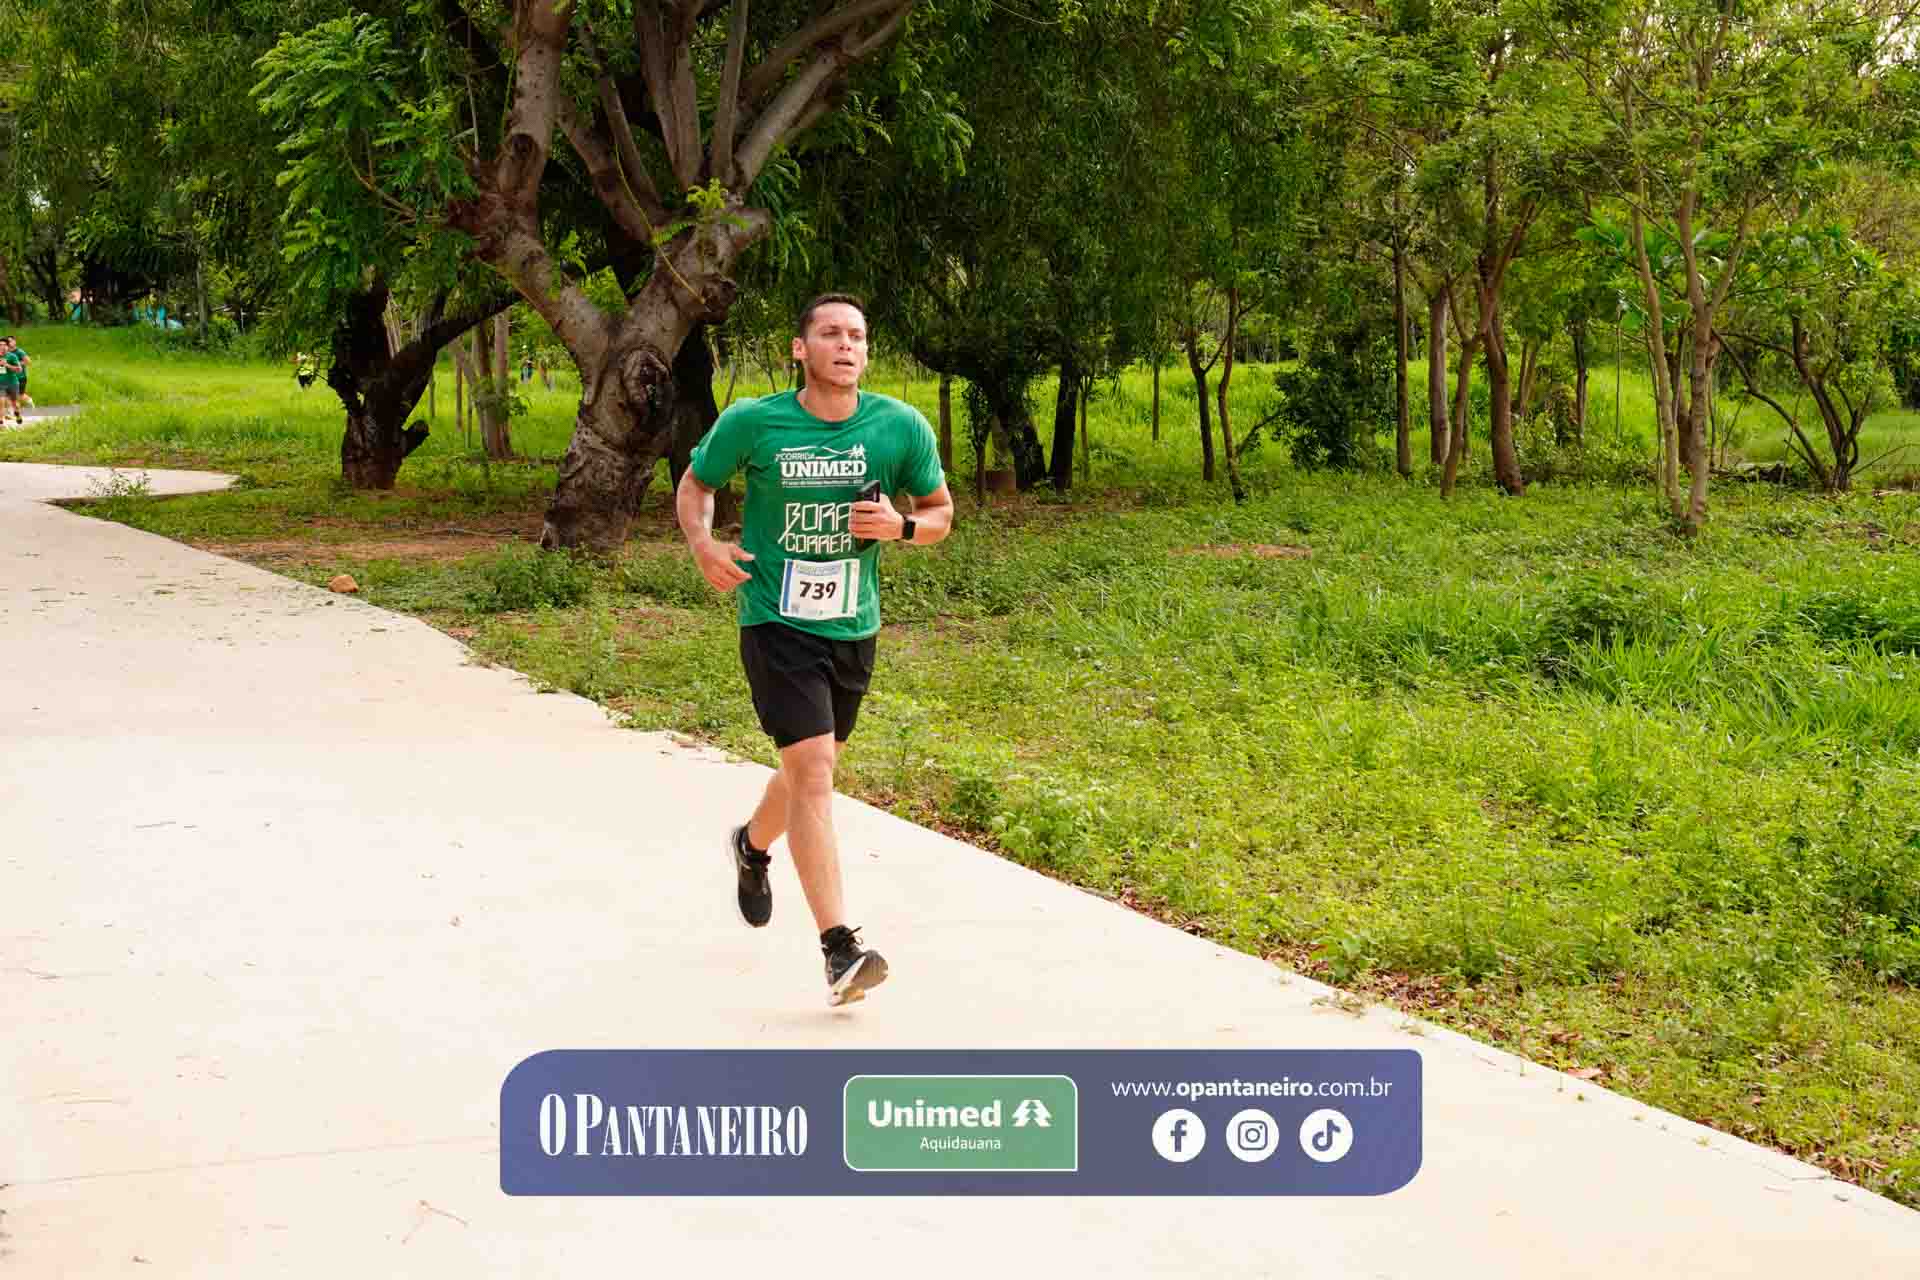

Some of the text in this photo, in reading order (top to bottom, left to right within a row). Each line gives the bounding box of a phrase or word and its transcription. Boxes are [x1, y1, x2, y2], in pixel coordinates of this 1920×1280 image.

[781, 460, 867, 477] UNIMED
[785, 531, 852, 554] CORRER
[799, 580, 837, 600] 739
